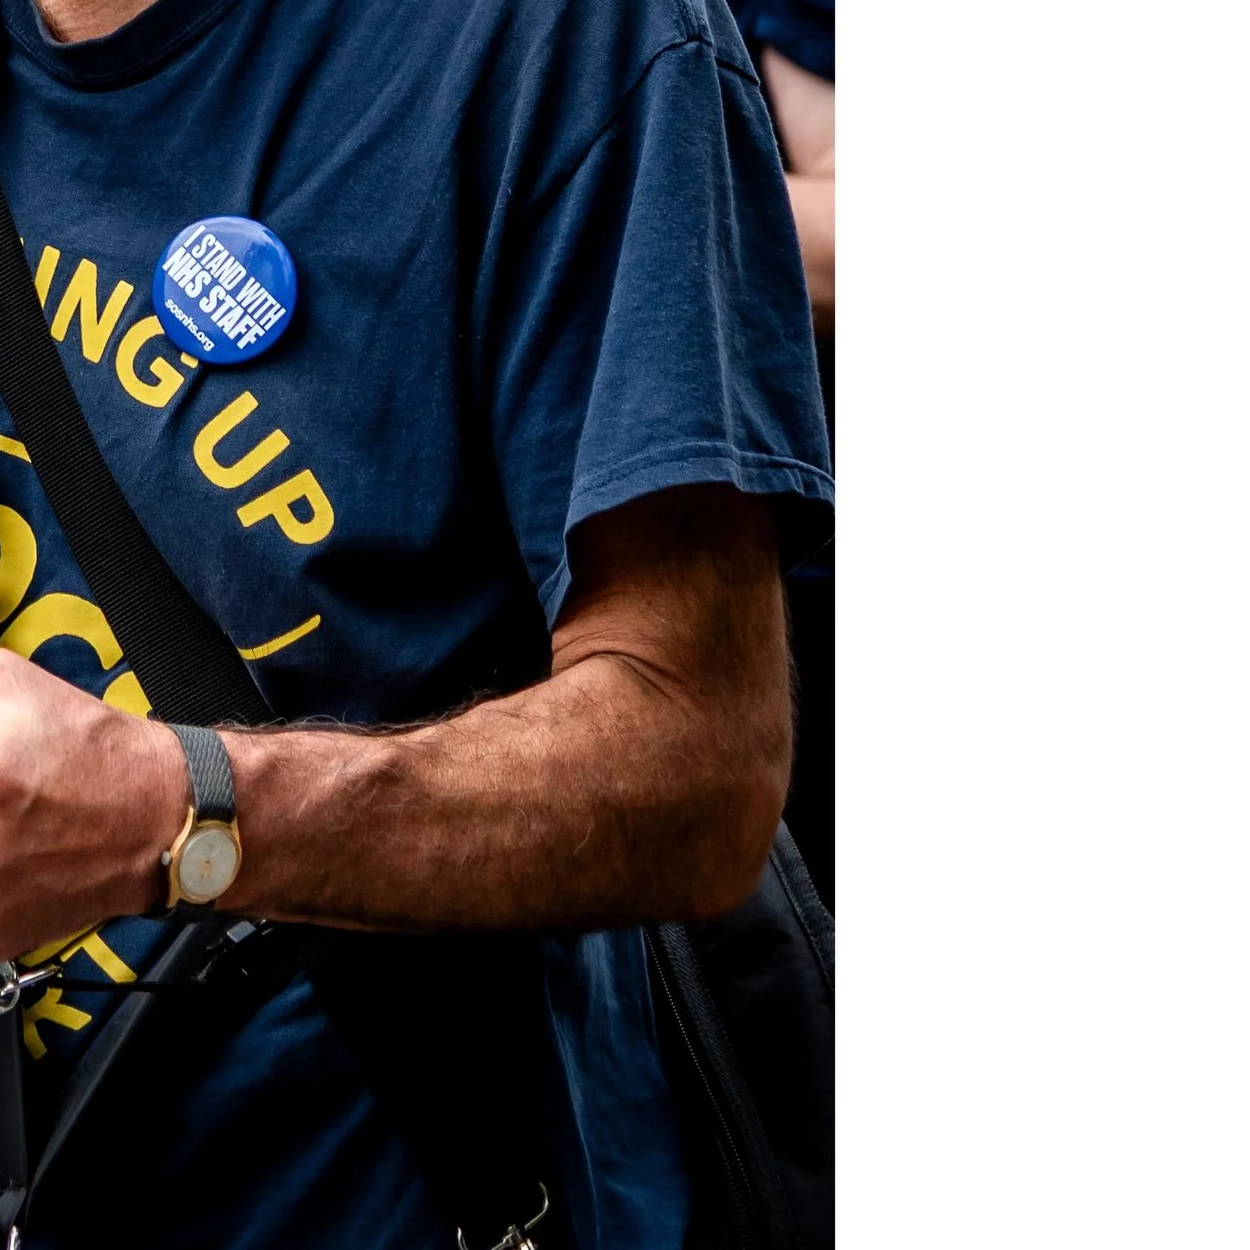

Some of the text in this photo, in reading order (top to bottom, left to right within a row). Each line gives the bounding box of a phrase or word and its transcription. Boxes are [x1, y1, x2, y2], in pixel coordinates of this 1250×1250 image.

[162, 246, 266, 349] NHS STAFF
[165, 299, 215, 352] sosnhs.org
[181, 225, 286, 331] I STAND WITH
[192, 390, 336, 546] UP
